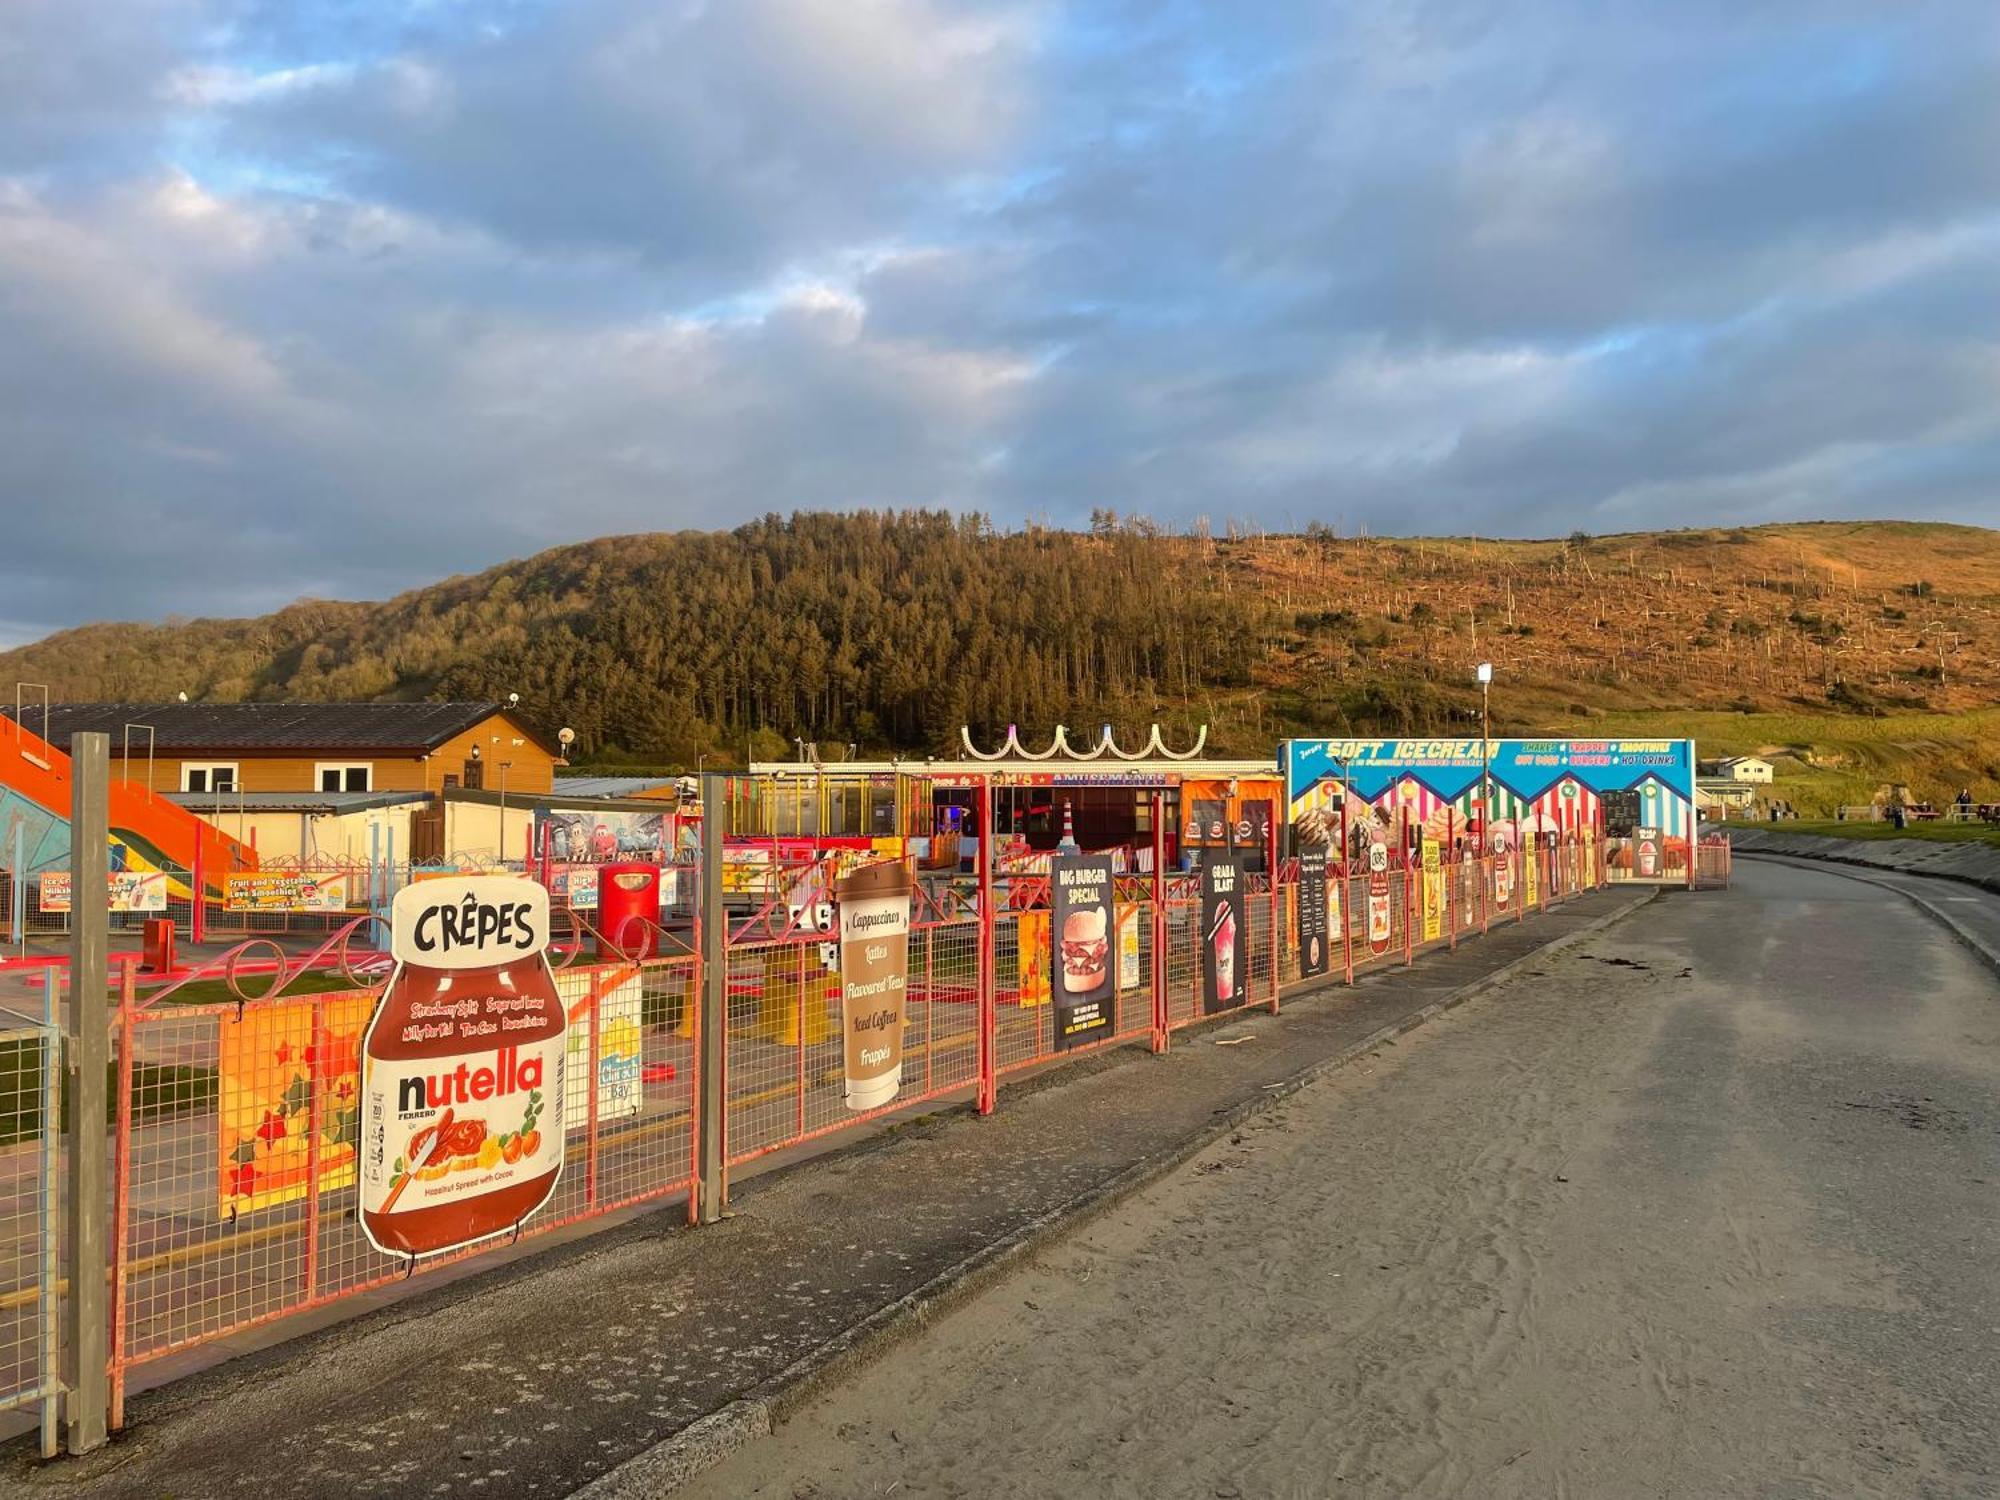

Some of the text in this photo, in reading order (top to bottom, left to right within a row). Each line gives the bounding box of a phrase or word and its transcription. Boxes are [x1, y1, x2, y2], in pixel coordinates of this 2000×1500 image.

[1325, 742, 1501, 759] SOFT ICECREAM
[1621, 755, 1639, 765] HOT
[1640, 755, 1676, 766] DRINKS
[1052, 773, 1167, 785] AMUSEMENTS
[252, 879, 268, 887] and
[1059, 868, 1107, 885] BIG BURGER
[251, 888, 297, 897] Smoothies
[1214, 879, 1234, 893] BLAST
[1068, 888, 1100, 904] SPECIAL
[414, 891, 534, 952] CRÊPES
[852, 910, 900, 931] Cappuccinos
[865, 945, 888, 964] Lattes
[846, 973, 905, 999] Flavoured Teas
[457, 999, 479, 1017] Split
[486, 997, 511, 1014] Sugar
[853, 1009, 897, 1033] Iced Coffees
[398, 1045, 543, 1112] nutella
[611, 1083, 630, 1100] Bay
[398, 1110, 436, 1120] FERRERO
[424, 1170, 514, 1197] Hazelnut Spread with Cocoa
